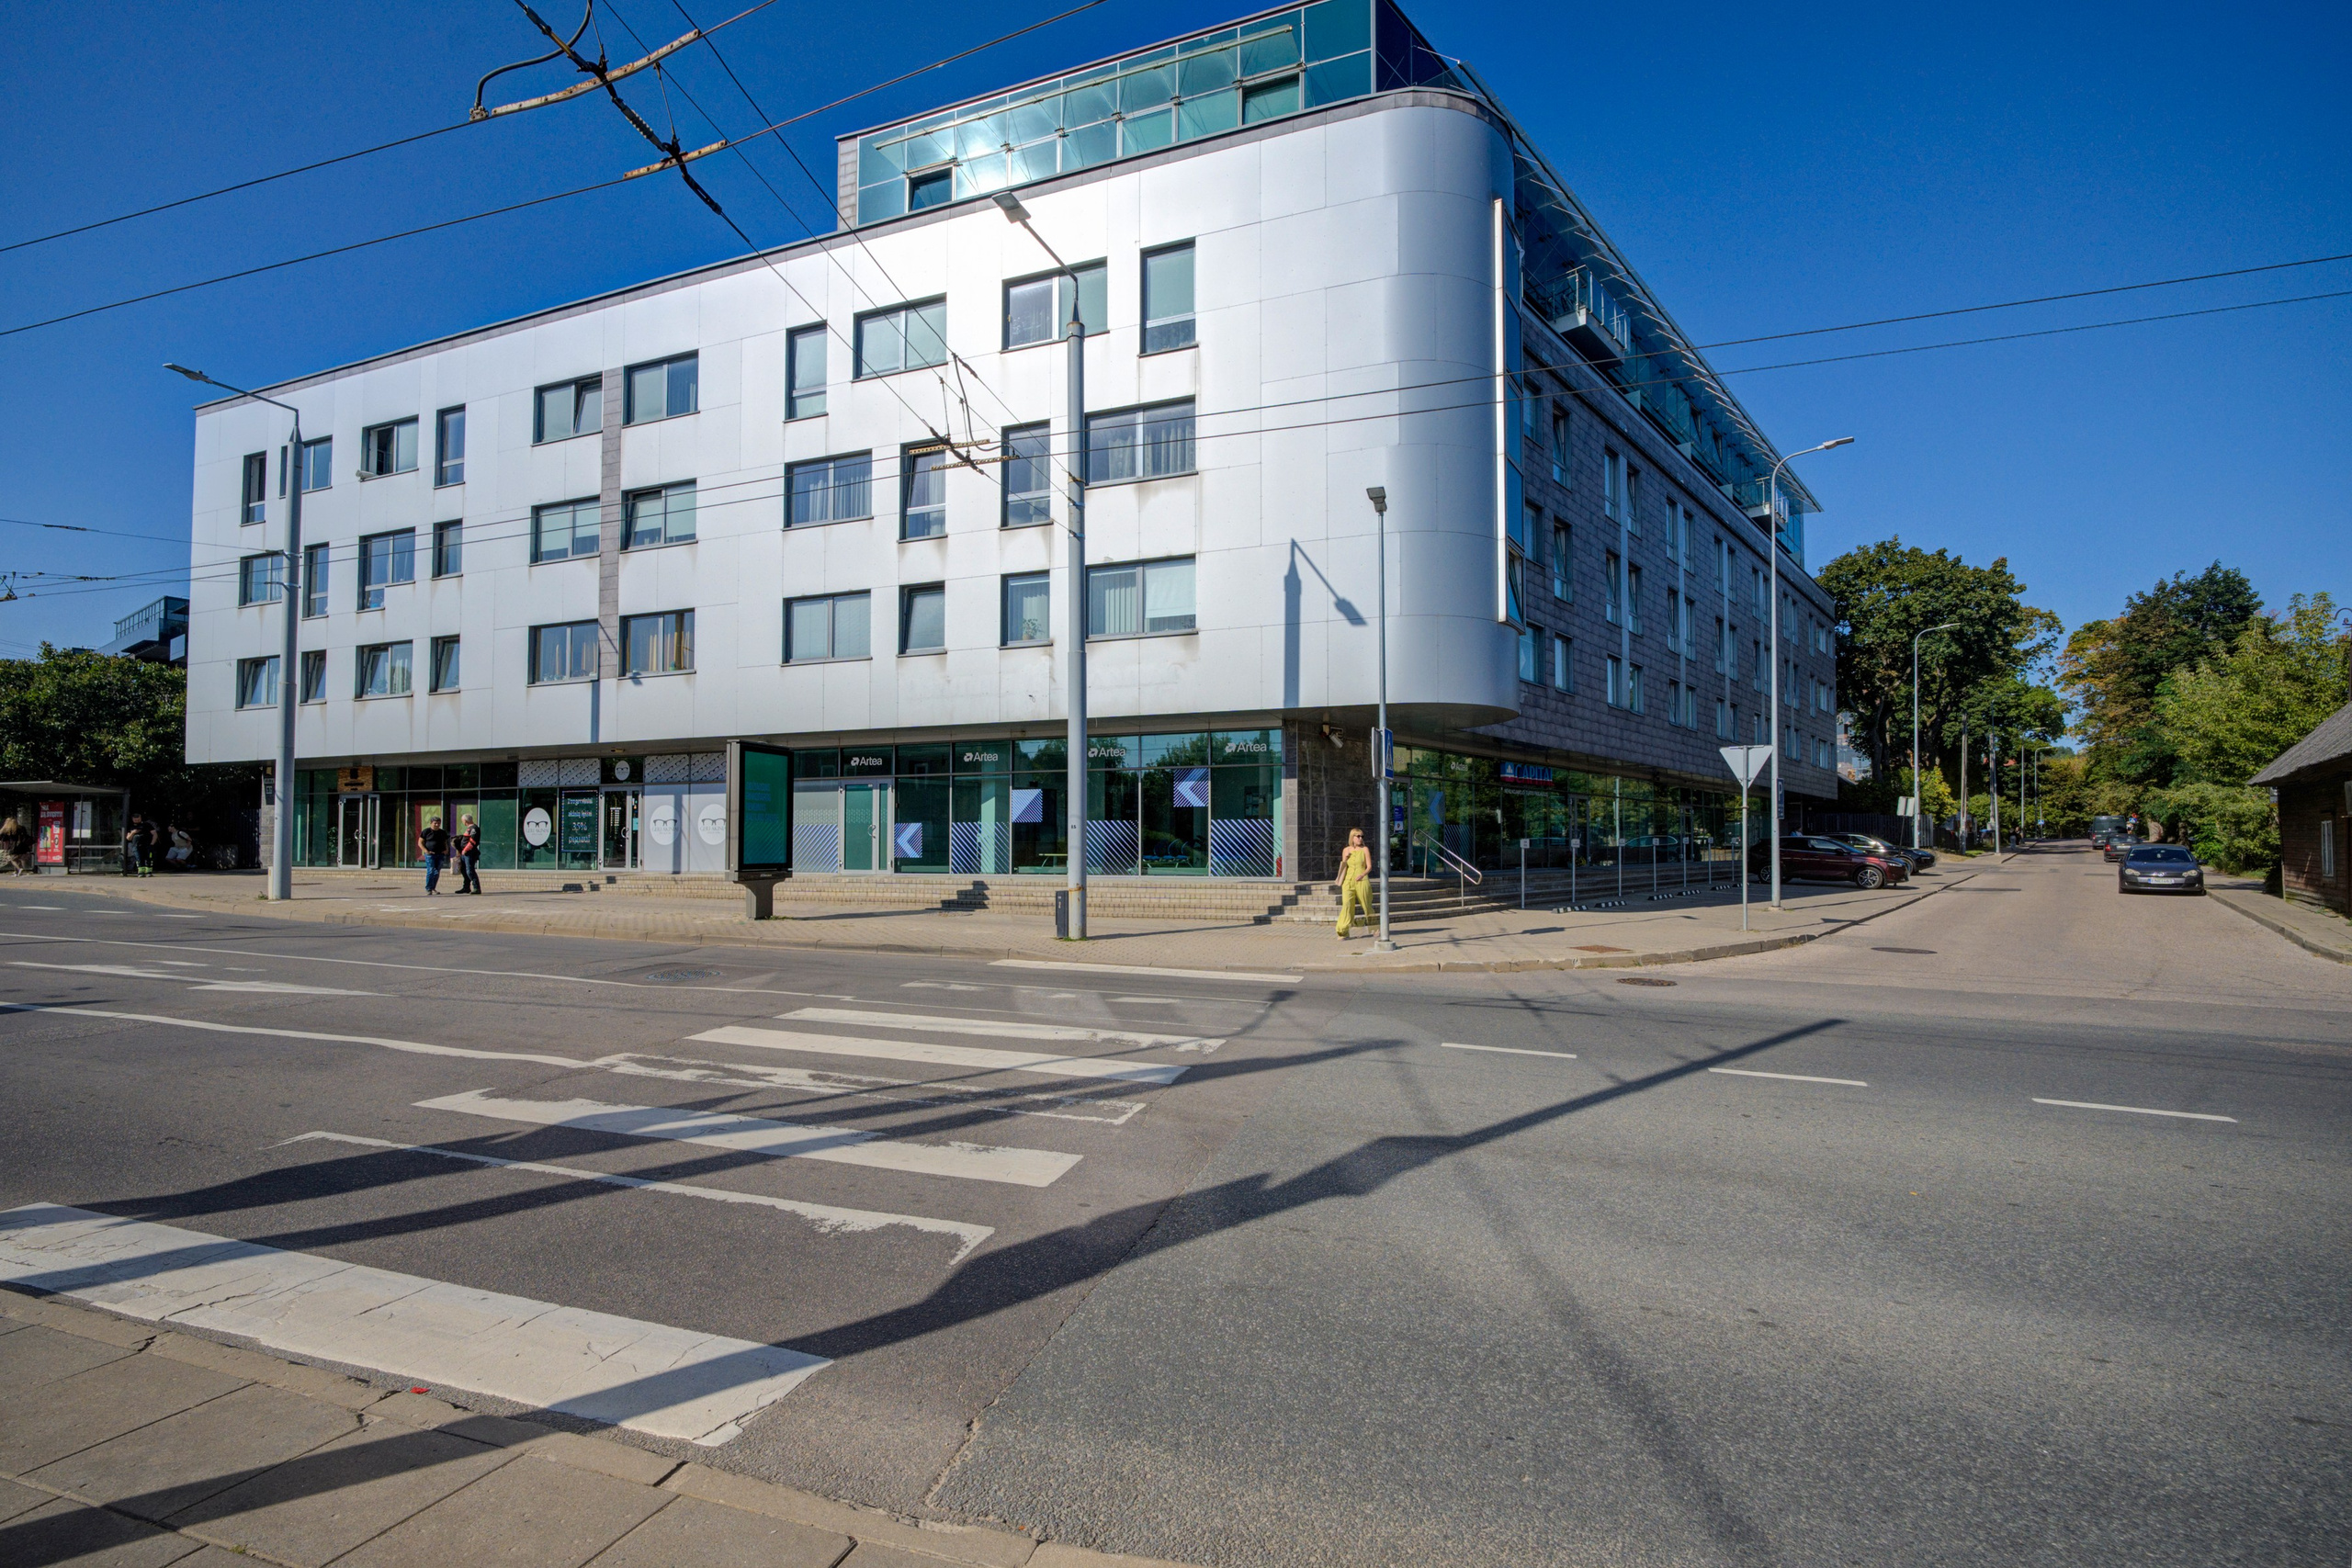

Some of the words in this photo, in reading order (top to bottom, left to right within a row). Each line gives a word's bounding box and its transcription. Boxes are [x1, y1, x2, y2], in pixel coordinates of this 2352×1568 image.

[1237, 742, 1267, 752] Artea
[974, 752, 999, 761] Artea
[1099, 747, 1126, 757] Artea
[860, 757, 883, 766] Artea
[1515, 763, 1555, 786] CAPITAL
[572, 822, 588, 830] 35%
